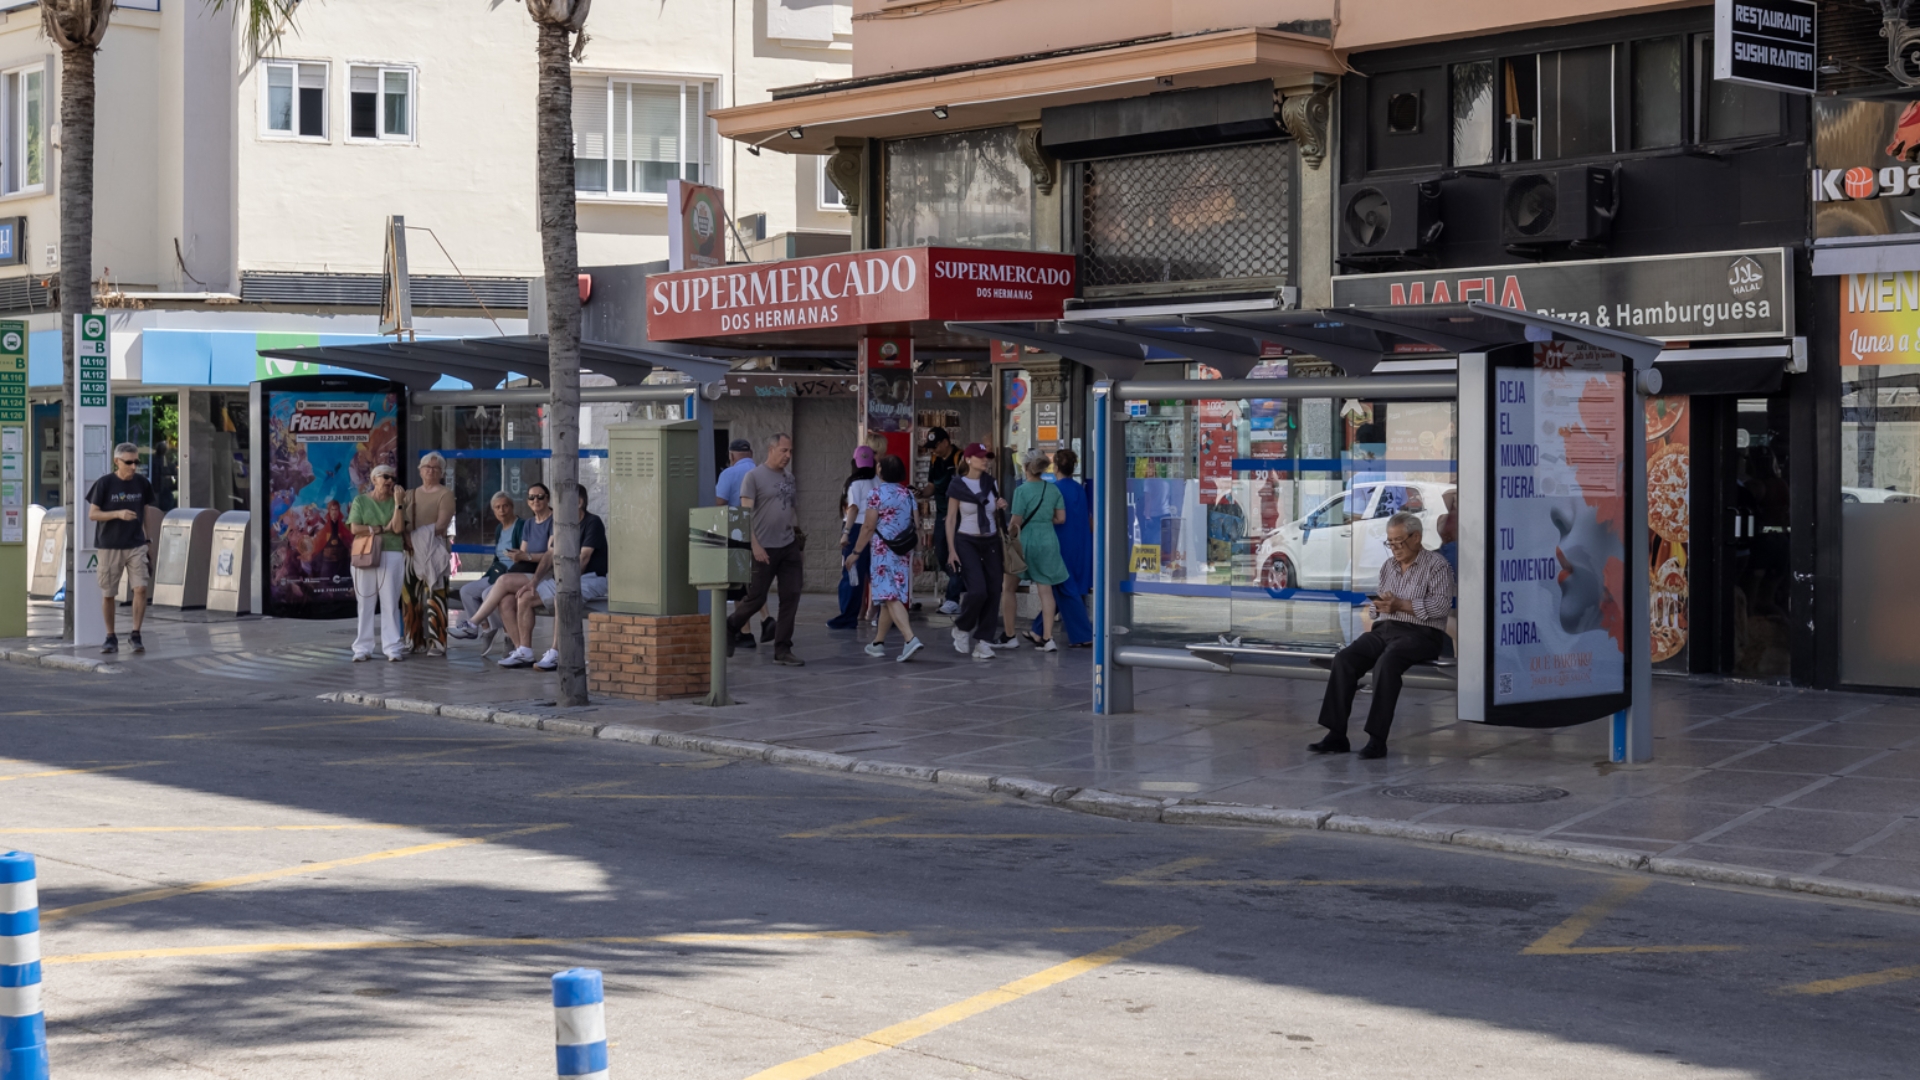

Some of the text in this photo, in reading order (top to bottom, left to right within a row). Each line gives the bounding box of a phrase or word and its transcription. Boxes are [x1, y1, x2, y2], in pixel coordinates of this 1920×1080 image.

[1735, 4, 1812, 38] RESTAURANTE
[1734, 41, 1813, 72] SUSHI RAMEN
[934, 260, 1072, 286] SUPERMERCADO
[1729, 262, 1764, 286] حلال
[652, 255, 917, 316] SUPERMERCADO
[976, 287, 1033, 300] DOS HERMANAS
[1390, 275, 1528, 311] MAFIA
[1733, 283, 1761, 296] HALAL
[721, 305, 839, 332] DOS HERMANAS
[1596, 304, 1611, 328] &
[1616, 300, 1771, 328] Hamburguesa
[95, 342, 105, 353] B
[1849, 328, 1895, 361] Lunes
[1898, 334, 1909, 352] a
[15, 357, 26, 369] B
[82, 358, 105, 366] M.110
[82, 371, 105, 379] M.112
[82, 384, 105, 392] M.120
[1500, 381, 1526, 404] DEJA
[82, 397, 105, 405] M.121
[1500, 412, 1513, 435] EL
[1500, 444, 1540, 467] MUNDO
[1500, 475, 1546, 499] FUERA...
[1500, 527, 1515, 551] TU
[1500, 557, 1556, 582] MOMENTO
[1500, 591, 1514, 615] ES
[1500, 621, 1541, 646] AHORA.
